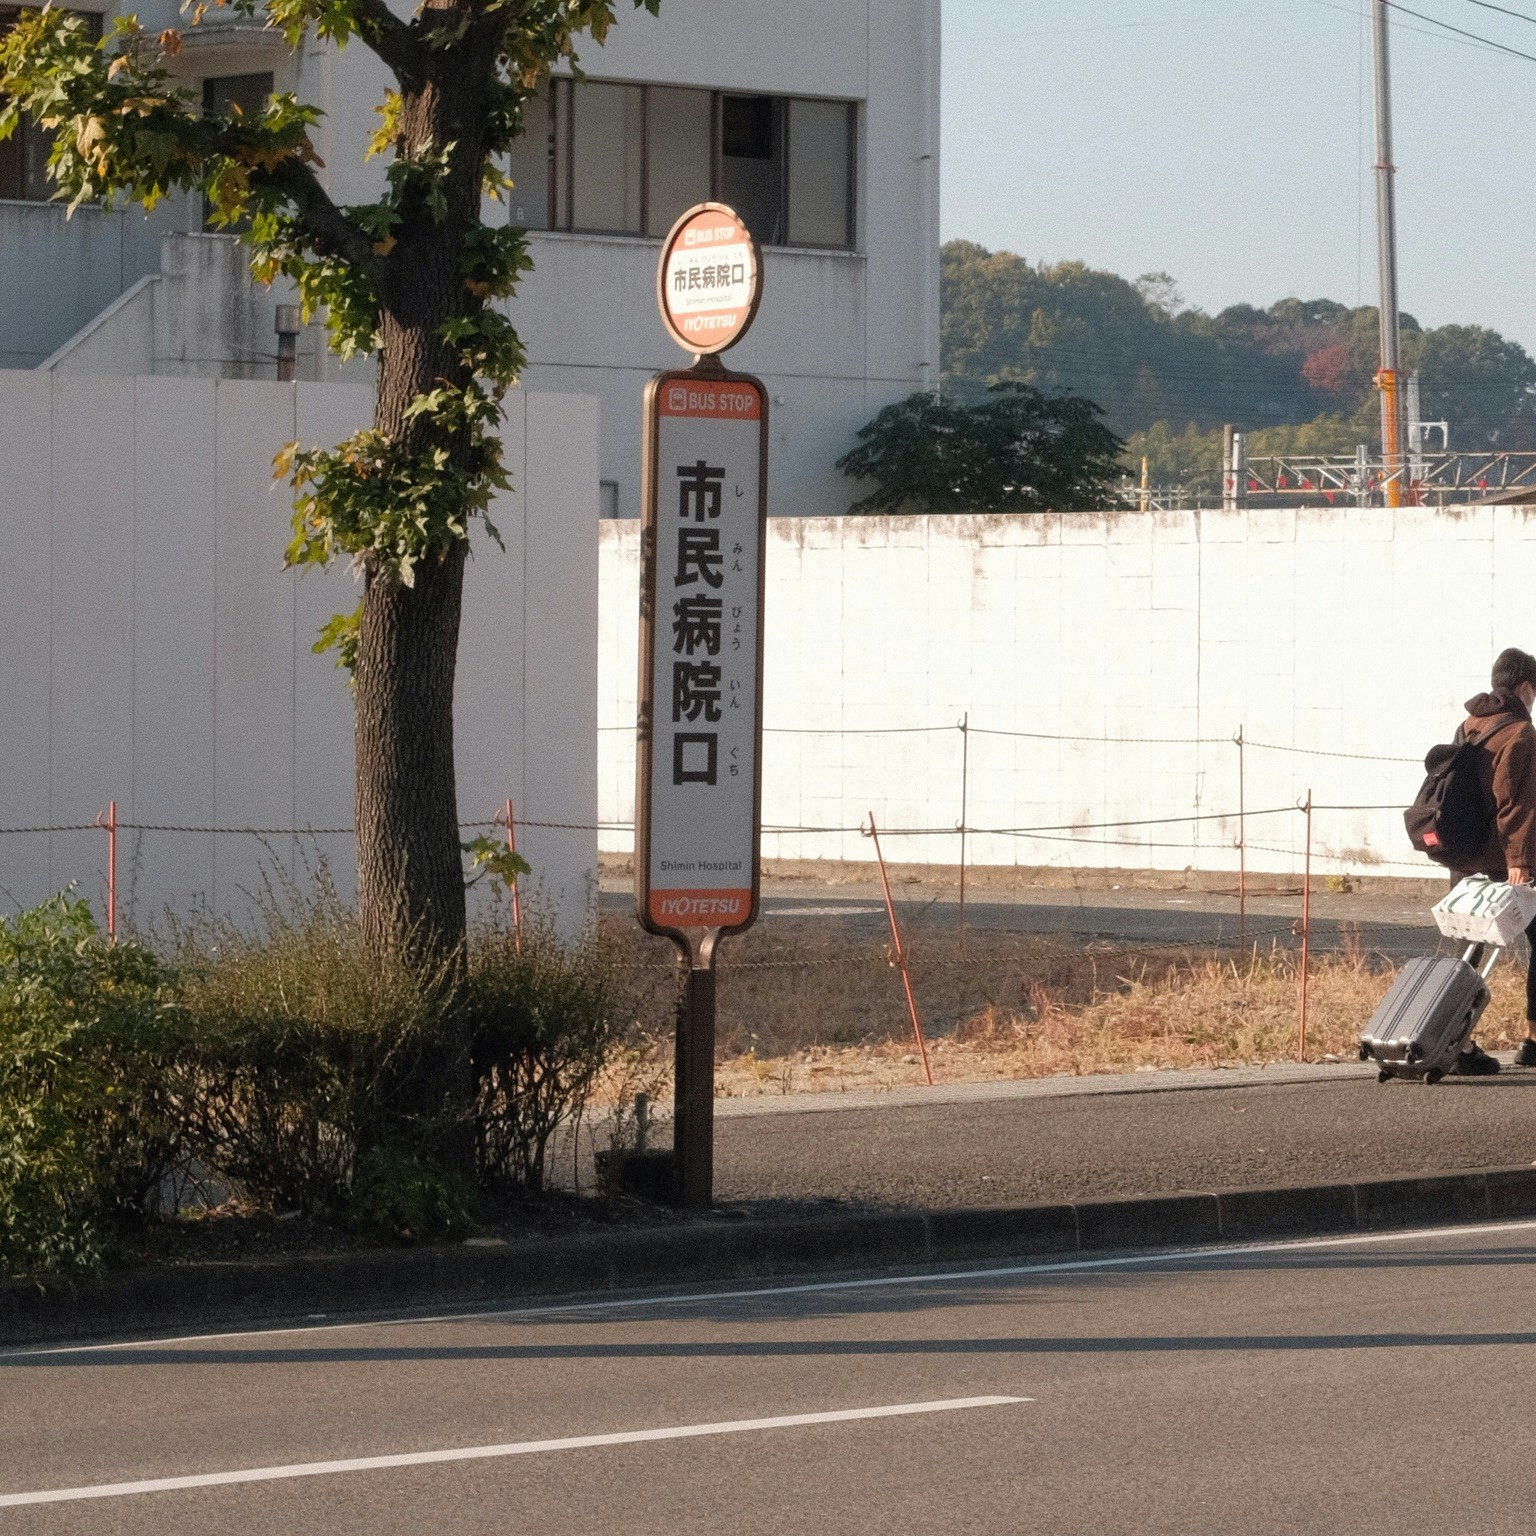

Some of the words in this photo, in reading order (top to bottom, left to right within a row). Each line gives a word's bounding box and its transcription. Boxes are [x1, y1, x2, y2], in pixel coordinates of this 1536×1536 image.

[674, 263, 744, 292] 市民病院口
[684, 314, 736, 332] IYOTETSU
[689, 392, 715, 410] BUS
[719, 393, 753, 412] STOP
[672, 460, 726, 786] 市民病院口
[660, 860, 695, 872] Shimin
[698, 860, 742, 872] Hospital
[660, 896, 740, 916] IYOTETSU
